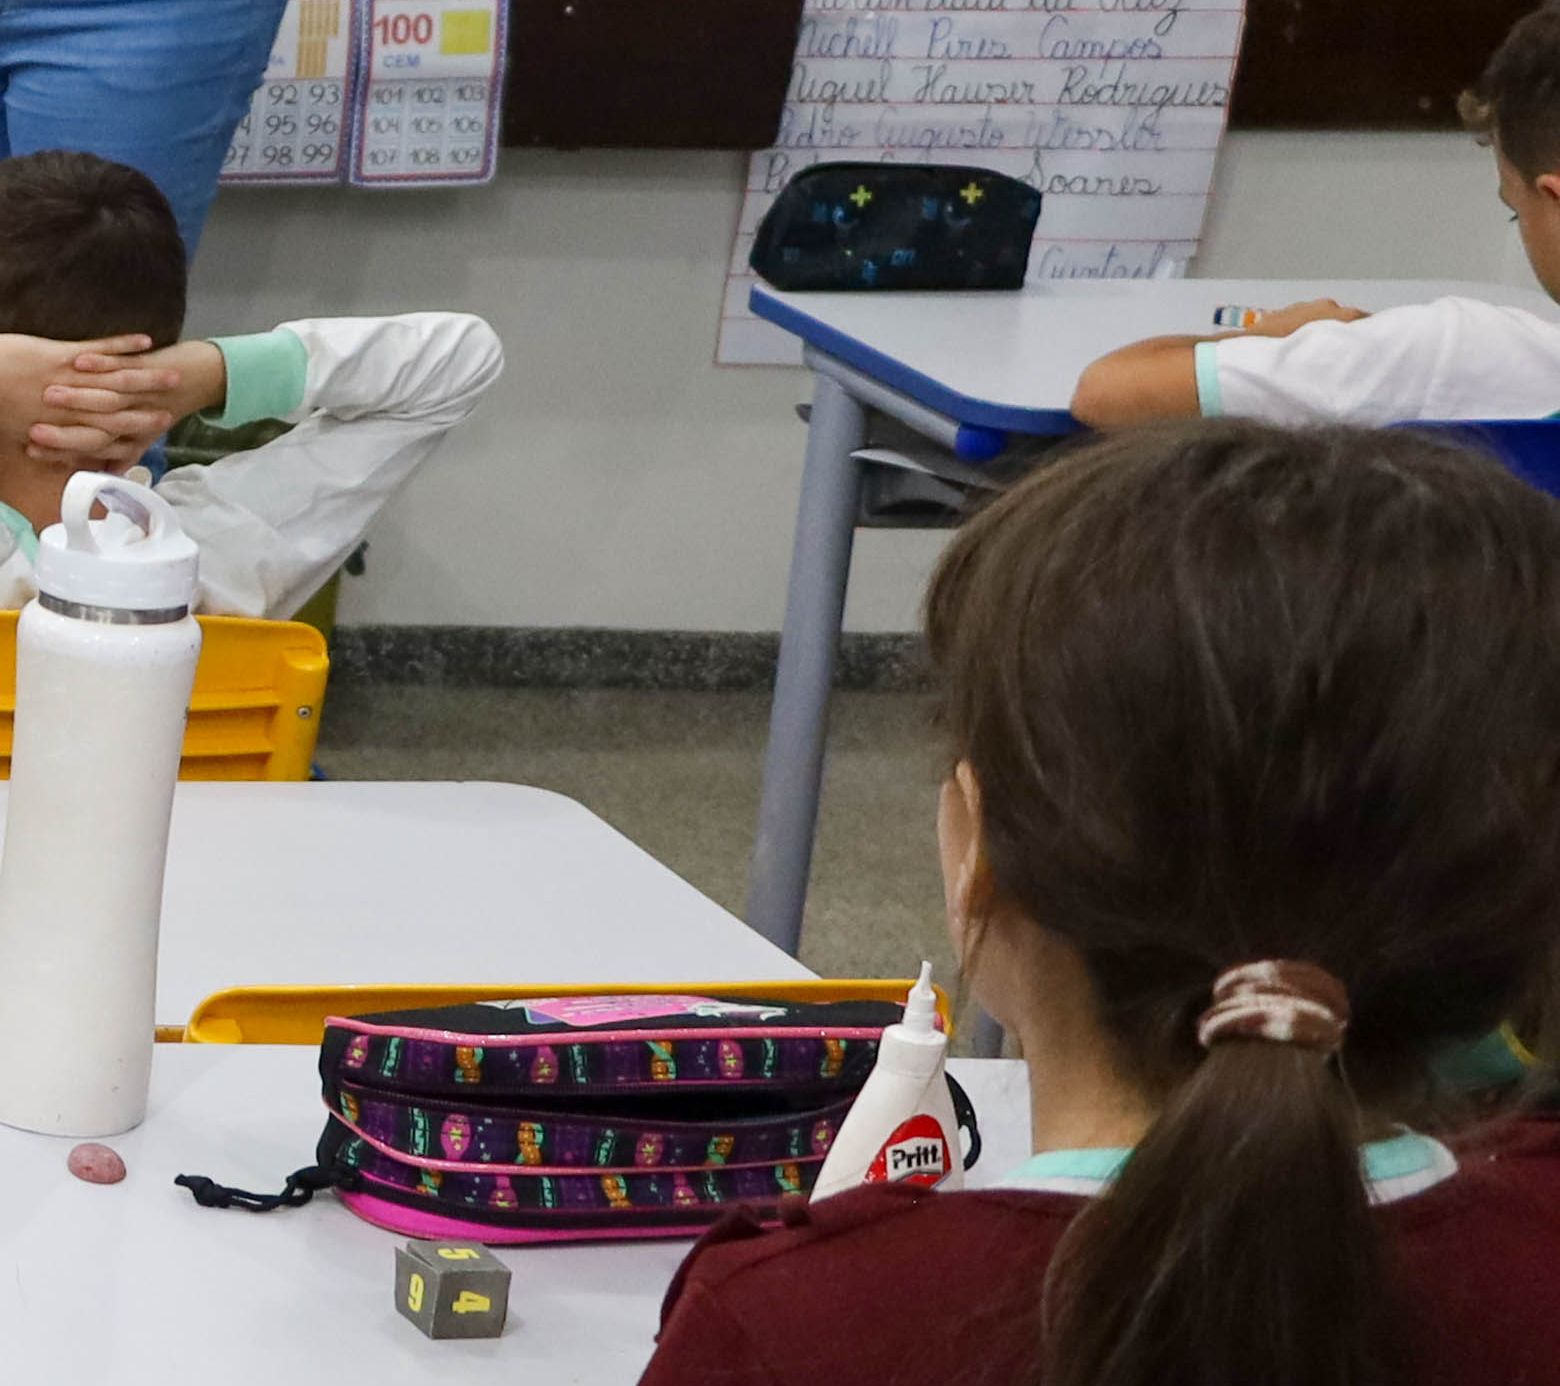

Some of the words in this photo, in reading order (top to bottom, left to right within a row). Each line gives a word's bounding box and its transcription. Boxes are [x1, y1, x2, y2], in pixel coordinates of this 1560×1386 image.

[372, 14, 433, 46] 100
[926, 15, 1012, 59] Pires
[1037, 14, 1164, 78] Campos
[383, 53, 420, 69] CEM
[1058, 64, 1230, 116] Rodrigues
[892, 1143, 938, 1170] Pritt
